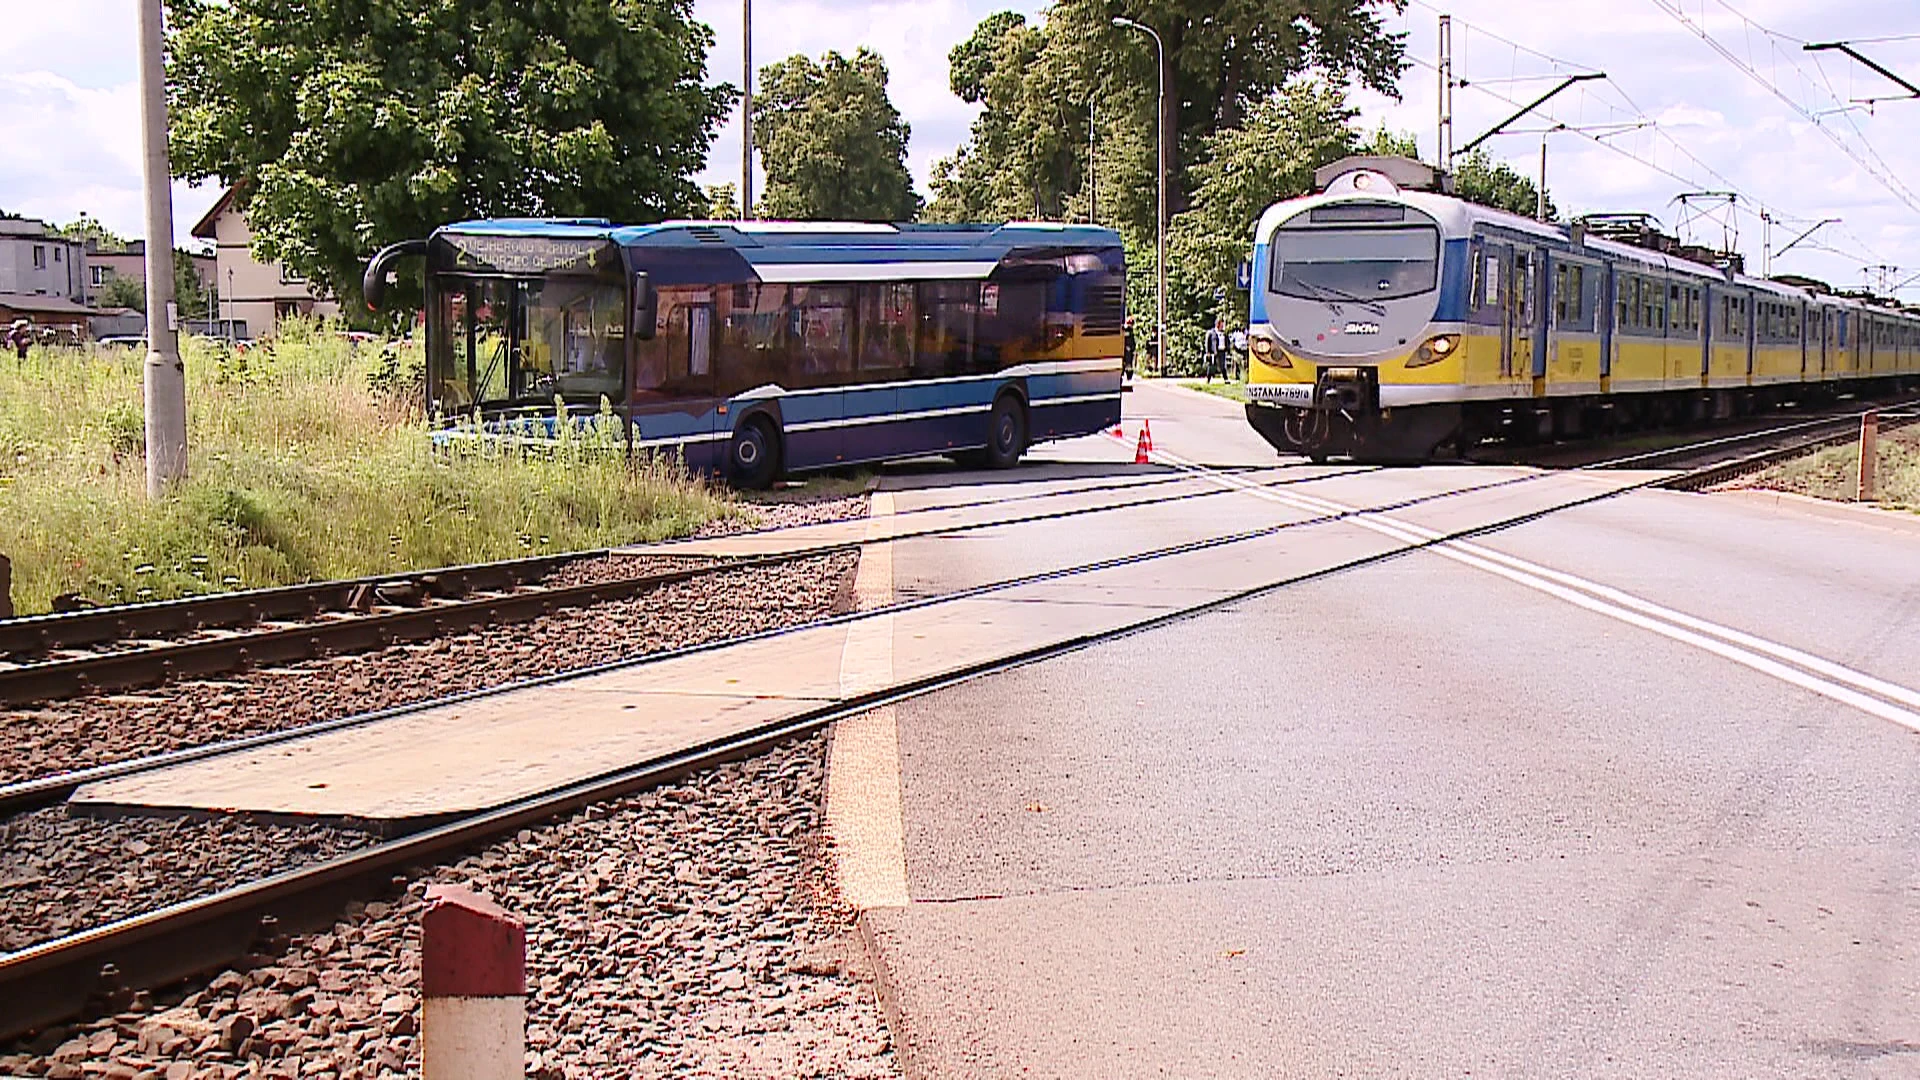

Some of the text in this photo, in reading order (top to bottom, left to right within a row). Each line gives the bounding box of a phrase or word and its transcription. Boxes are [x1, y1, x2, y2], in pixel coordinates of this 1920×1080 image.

[456, 239, 467, 265] 2
[476, 254, 529, 267] DWORZEC
[553, 257, 577, 269] PKP
[1344, 322, 1380, 335] SKM
